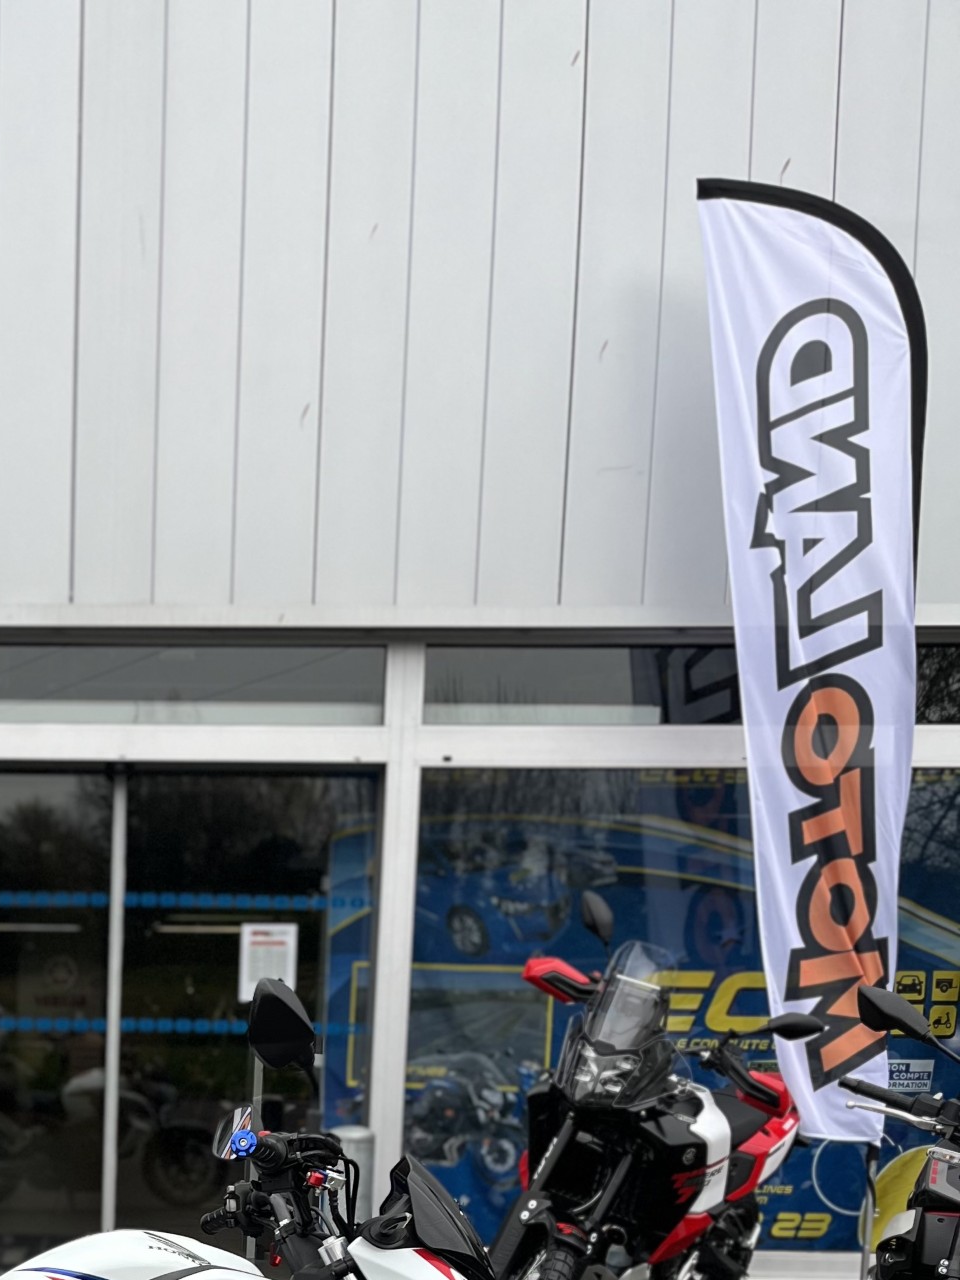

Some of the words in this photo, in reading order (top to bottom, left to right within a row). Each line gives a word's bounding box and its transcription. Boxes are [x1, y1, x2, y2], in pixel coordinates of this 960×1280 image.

[893, 1072, 929, 1080] COMPTE
[888, 1081, 928, 1089] ORMATION
[771, 1212, 832, 1239] 23
